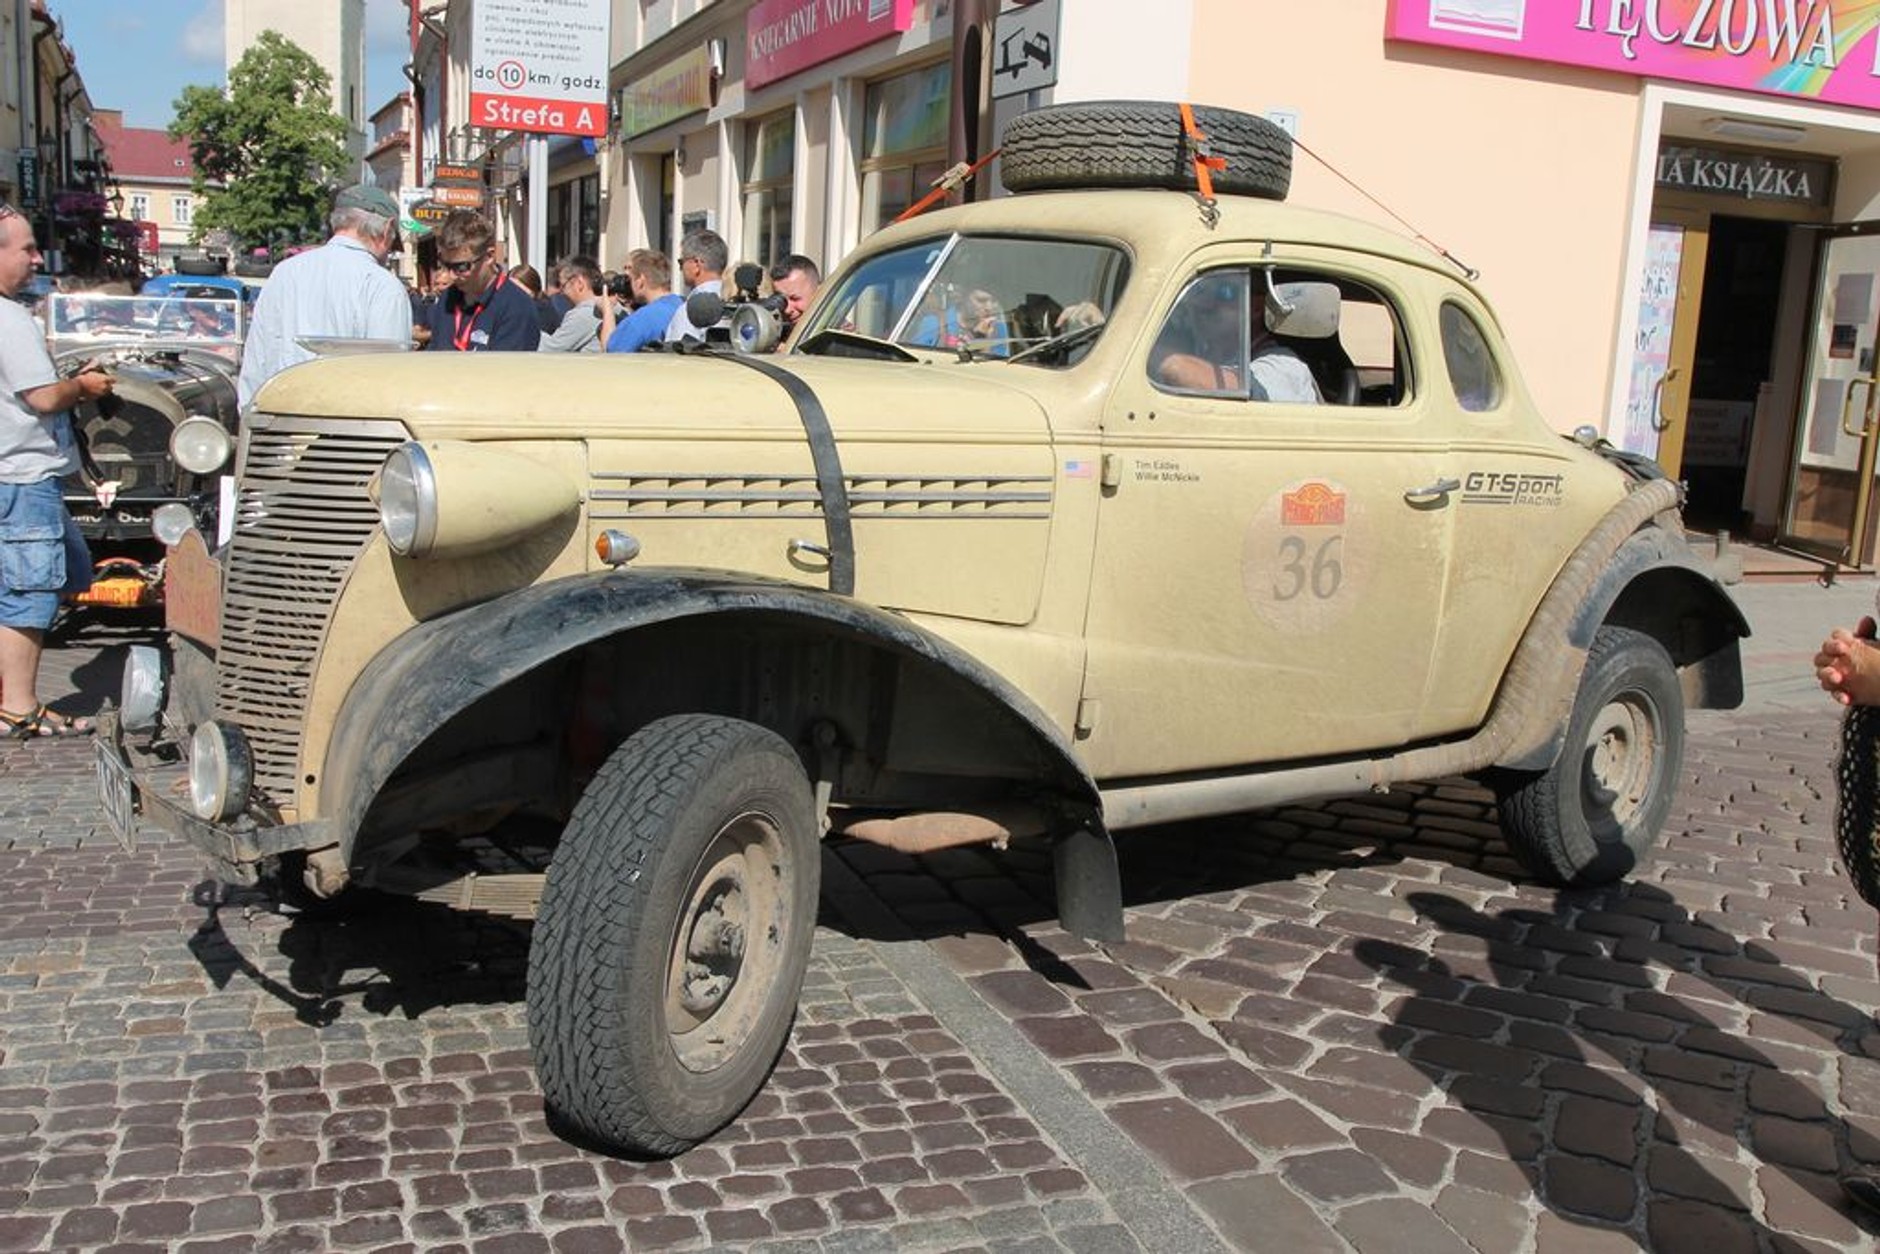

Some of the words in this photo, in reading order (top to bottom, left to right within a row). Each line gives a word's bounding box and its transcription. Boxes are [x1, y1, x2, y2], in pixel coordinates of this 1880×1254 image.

[474, 65, 495, 80] do
[503, 69, 520, 83] 10
[484, 99, 564, 127] Strefa
[576, 107, 593, 130] A
[1691, 159, 1811, 199] KSIĄŻKA
[1518, 495, 1562, 506] RACING
[1273, 535, 1343, 601] 36
